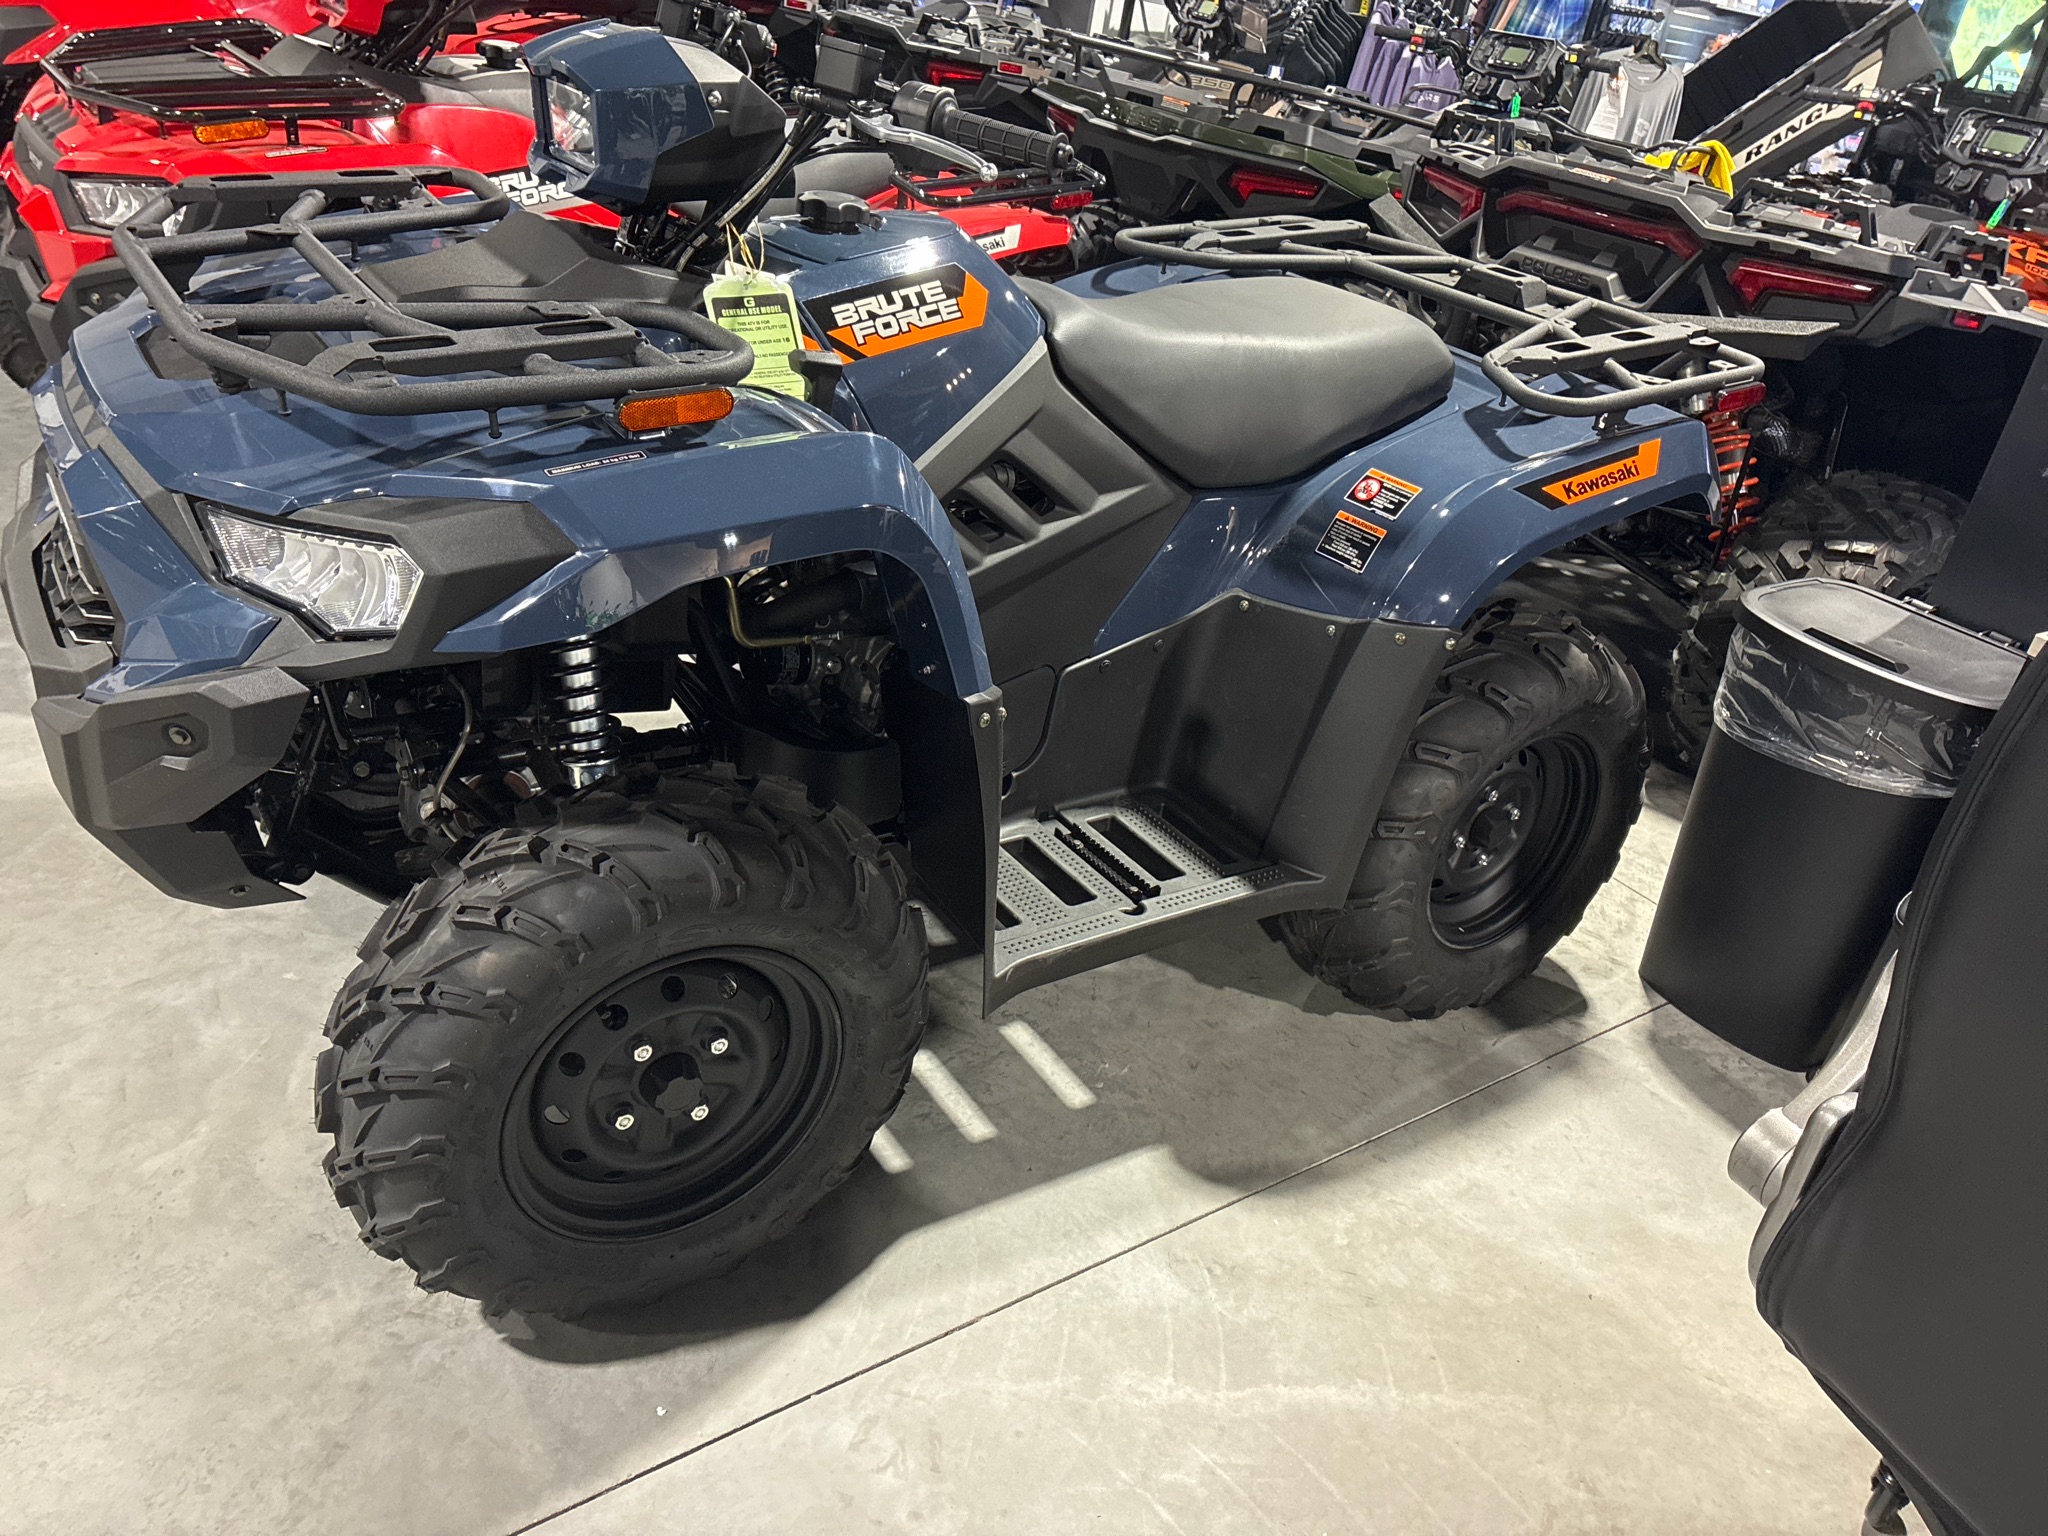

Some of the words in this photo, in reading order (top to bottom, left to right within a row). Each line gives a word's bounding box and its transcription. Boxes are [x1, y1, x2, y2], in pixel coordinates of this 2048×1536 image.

[982, 237, 1006, 251] saki
[1520, 256, 1591, 288] POLARIS
[721, 307, 748, 317] GENERAL
[748, 306, 760, 315] USE
[760, 305, 782, 314] MODEL
[743, 297, 755, 308] G
[831, 280, 947, 327] BRUTE
[851, 298, 962, 345] FORCE
[1386, 475, 1408, 488] WARNING
[1562, 460, 1640, 499] Kawasaki
[1351, 517, 1379, 534] WARNING
